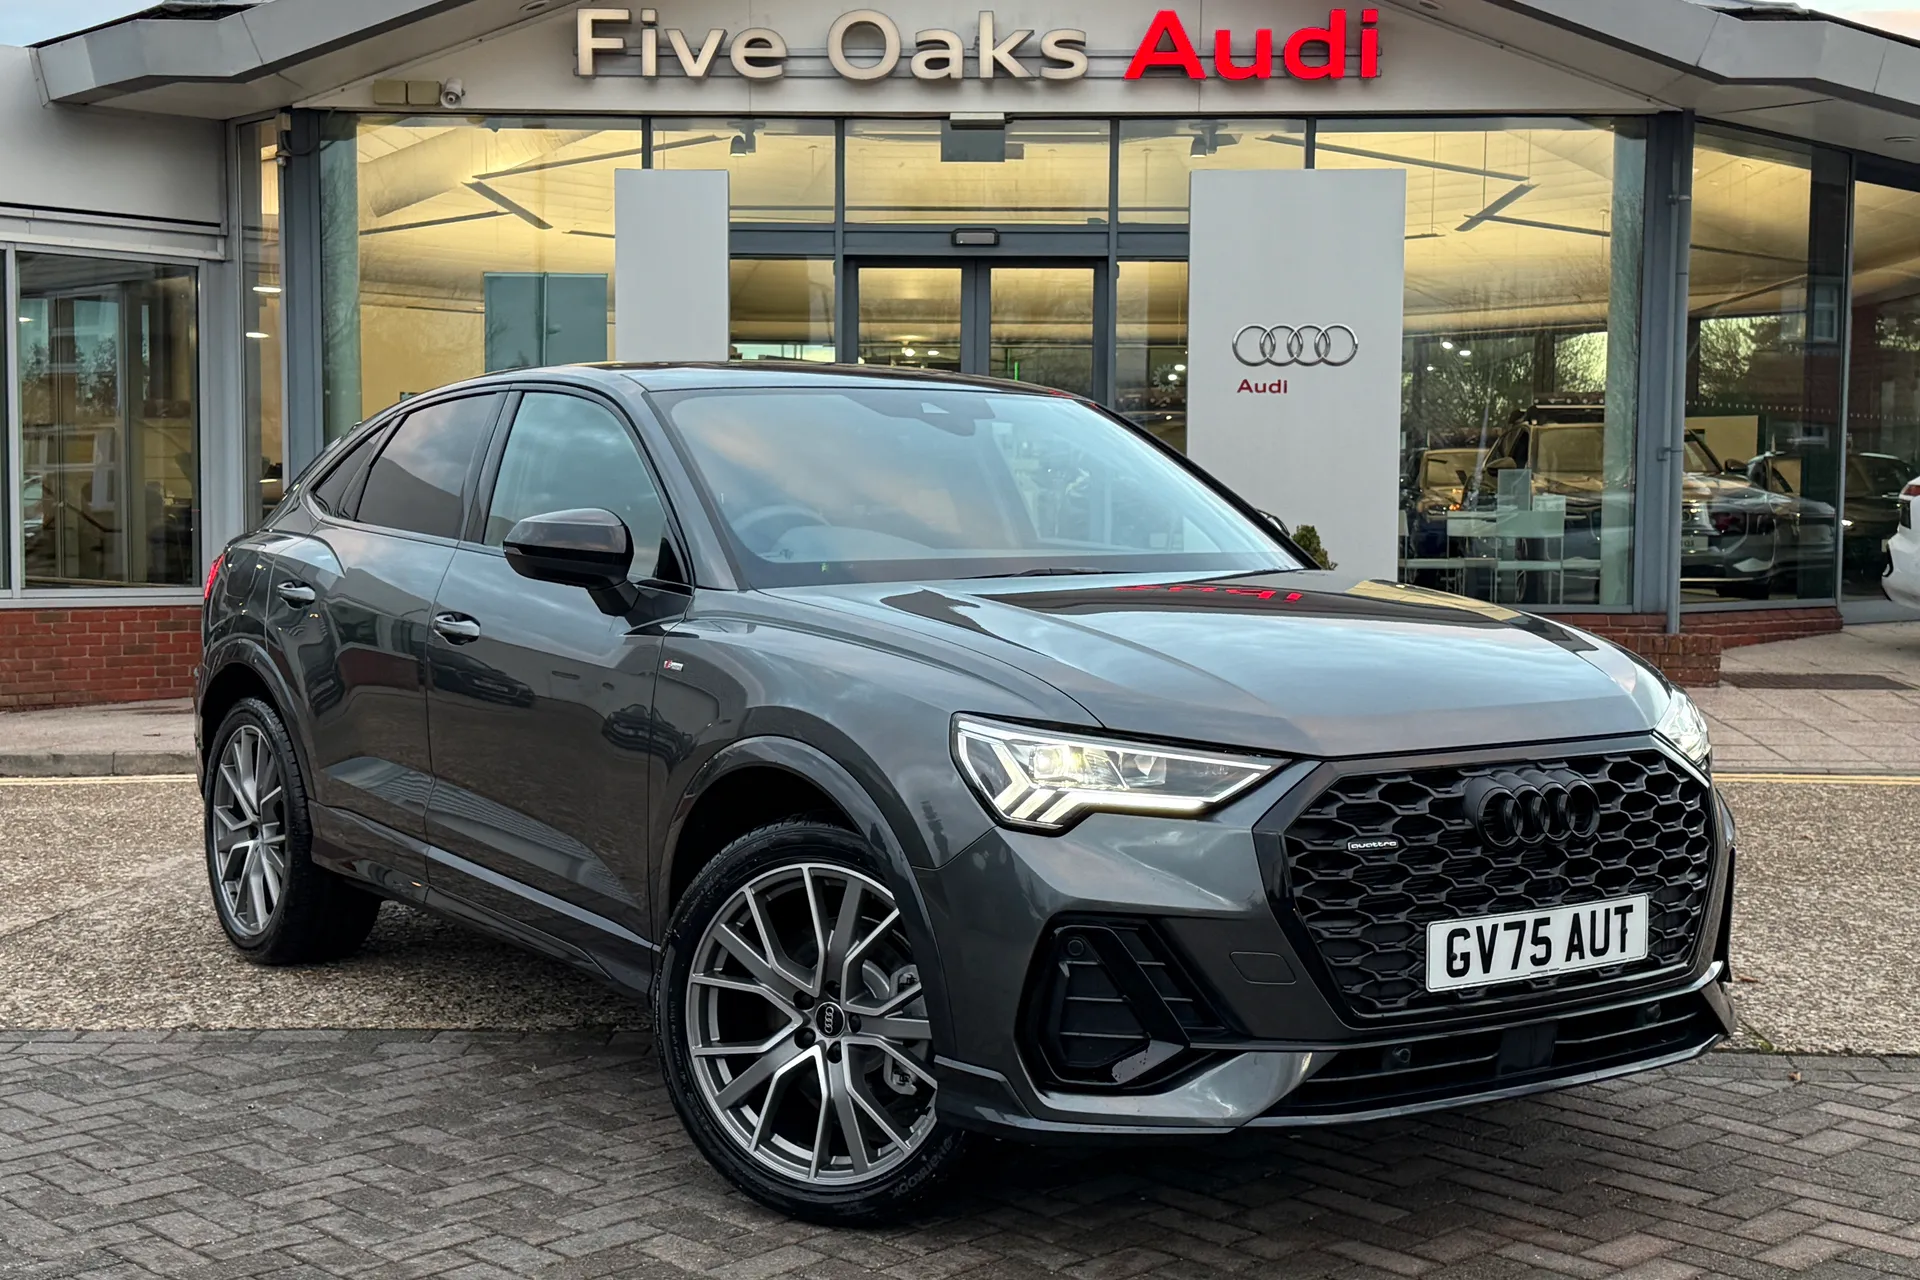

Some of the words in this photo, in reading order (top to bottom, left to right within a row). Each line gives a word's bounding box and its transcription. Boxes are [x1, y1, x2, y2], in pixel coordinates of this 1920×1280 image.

[576, 8, 788, 80] Five
[827, 9, 1088, 81] Oaks
[1123, 9, 1379, 80] Audi
[1237, 379, 1287, 393] Audi
[1350, 841, 1397, 849] quattro
[1446, 917, 1551, 978] GV75
[1565, 905, 1633, 962] AUT
